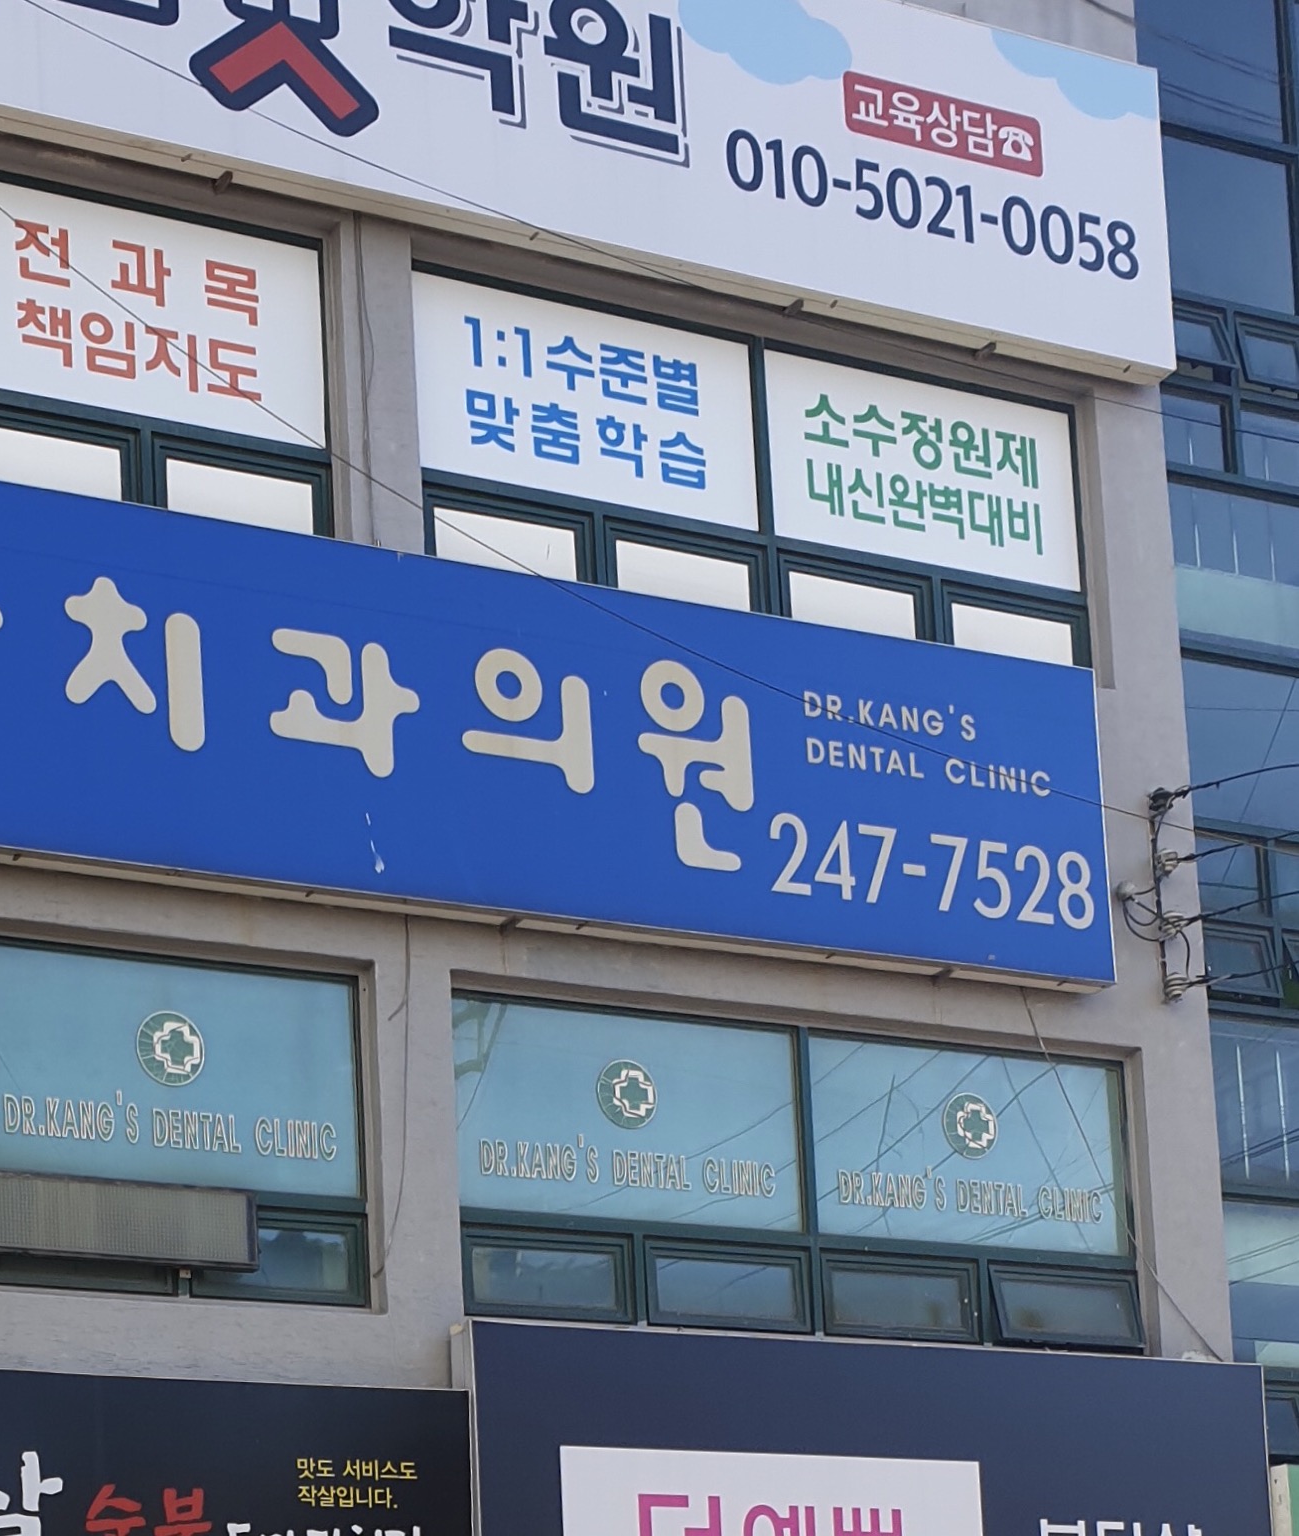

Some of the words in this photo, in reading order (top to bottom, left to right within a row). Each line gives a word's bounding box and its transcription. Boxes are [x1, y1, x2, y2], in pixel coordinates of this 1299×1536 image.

[850, 81, 997, 160] 교육상담
[725, 129, 1140, 280] 010-5021-0058
[16, 298, 262, 402] 책임지도
[464, 388, 707, 490] 맞춤학습
[803, 393, 1039, 489] 소수정원제
[806, 458, 1043, 555] 내신완벽대비
[803, 690, 977, 742] DR.KANG'S
[806, 736, 925, 779] DENTAL
[945, 757, 1051, 797] CLINIC
[769, 812, 1095, 930] 247-7528
[152, 1107, 242, 1154] DENTAL
[254, 1117, 337, 1161] CLINIC
[612, 1149, 692, 1191] DENTAL
[703, 1157, 776, 1198] CLINIC
[955, 1178, 1029, 1218] DENTAL
[1037, 1185, 1104, 1224] CLINIC
[295, 1457, 336, 1480] 맛도
[342, 1458, 418, 1481] 서비스도
[297, 1484, 399, 1509] 작살입니다.
